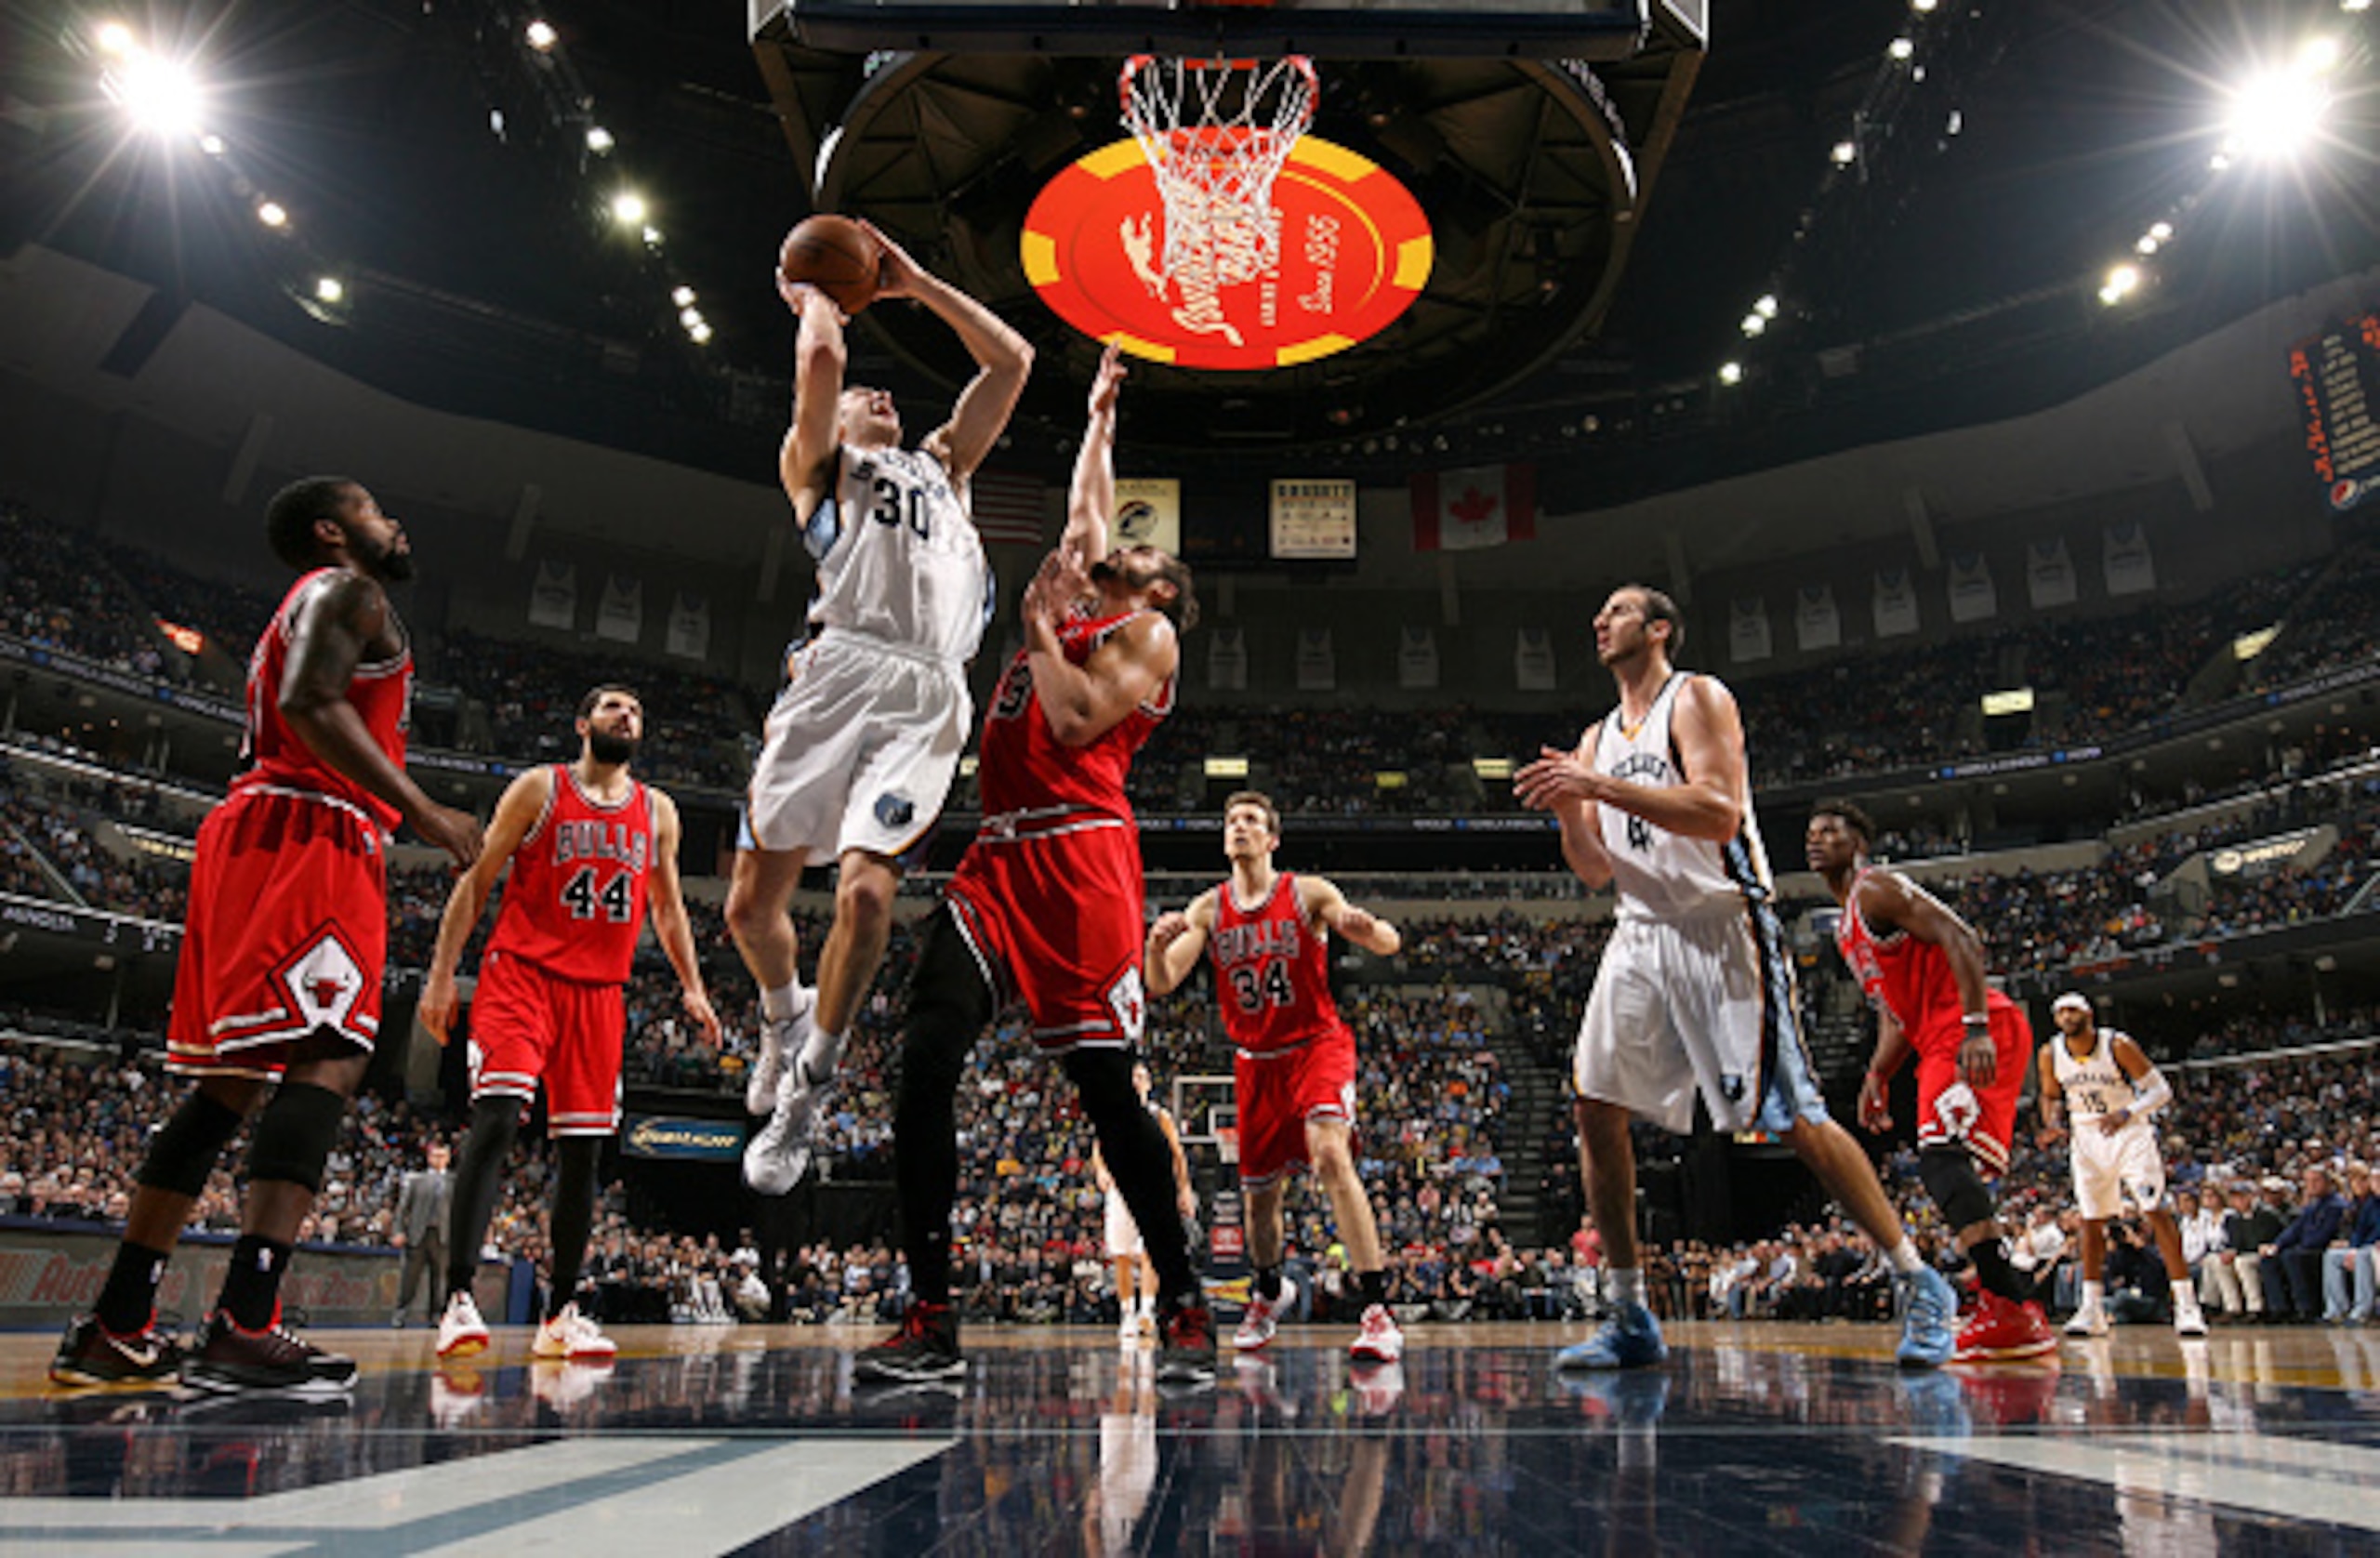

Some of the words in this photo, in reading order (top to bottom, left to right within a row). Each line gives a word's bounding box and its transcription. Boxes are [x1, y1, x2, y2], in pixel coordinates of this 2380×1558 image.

[873, 478, 929, 541] 30
[557, 822, 647, 873] BULLS
[560, 865, 633, 920] 44
[1216, 920, 1300, 968] BULLS
[1229, 961, 1296, 1014] 34
